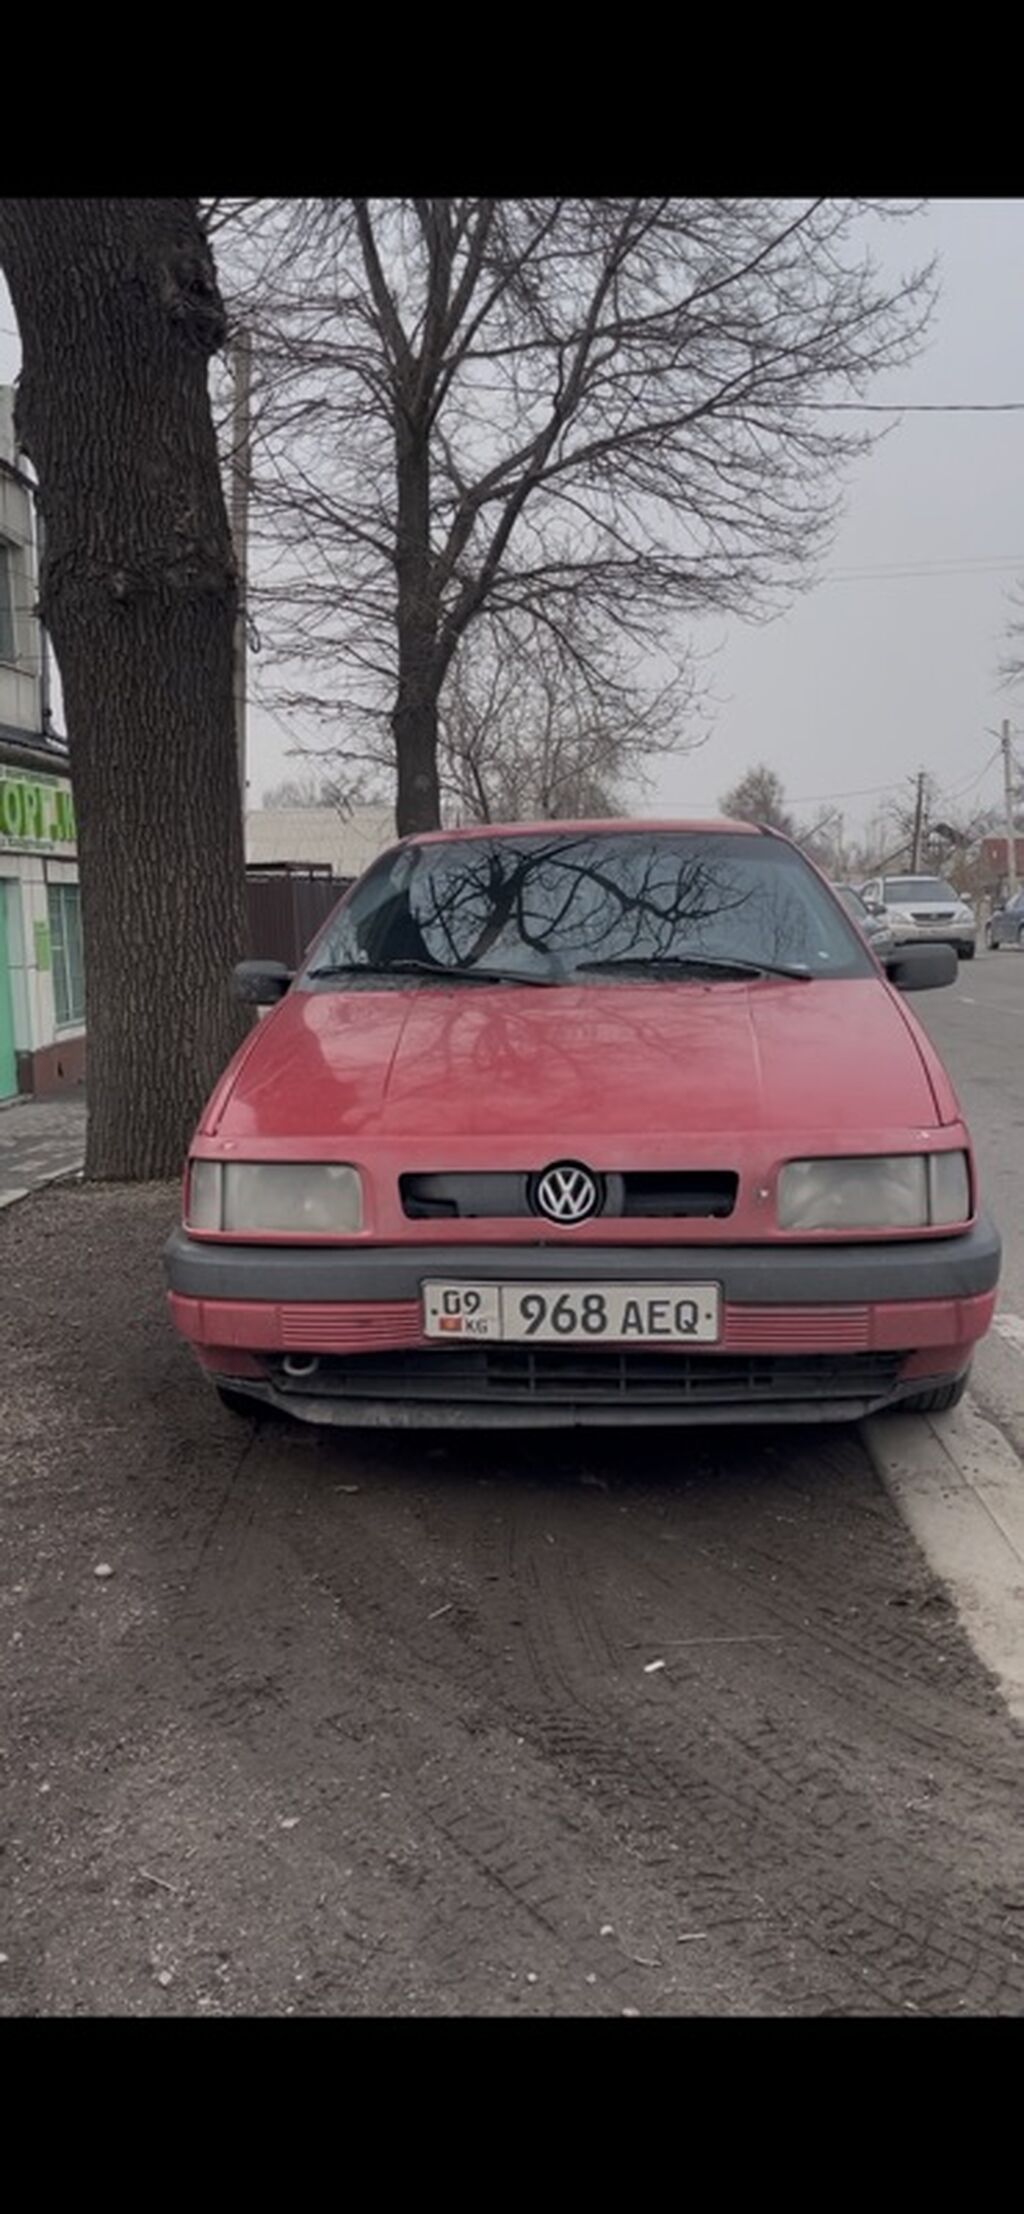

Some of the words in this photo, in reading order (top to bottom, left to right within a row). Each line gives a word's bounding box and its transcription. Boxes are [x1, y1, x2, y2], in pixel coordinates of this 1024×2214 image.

[539, 1167, 595, 1219] VW
[442, 1290, 482, 1316] 09
[519, 1293, 608, 1335] 968
[620, 1299, 699, 1335] AEQ
[464, 1318, 489, 1335] KG
